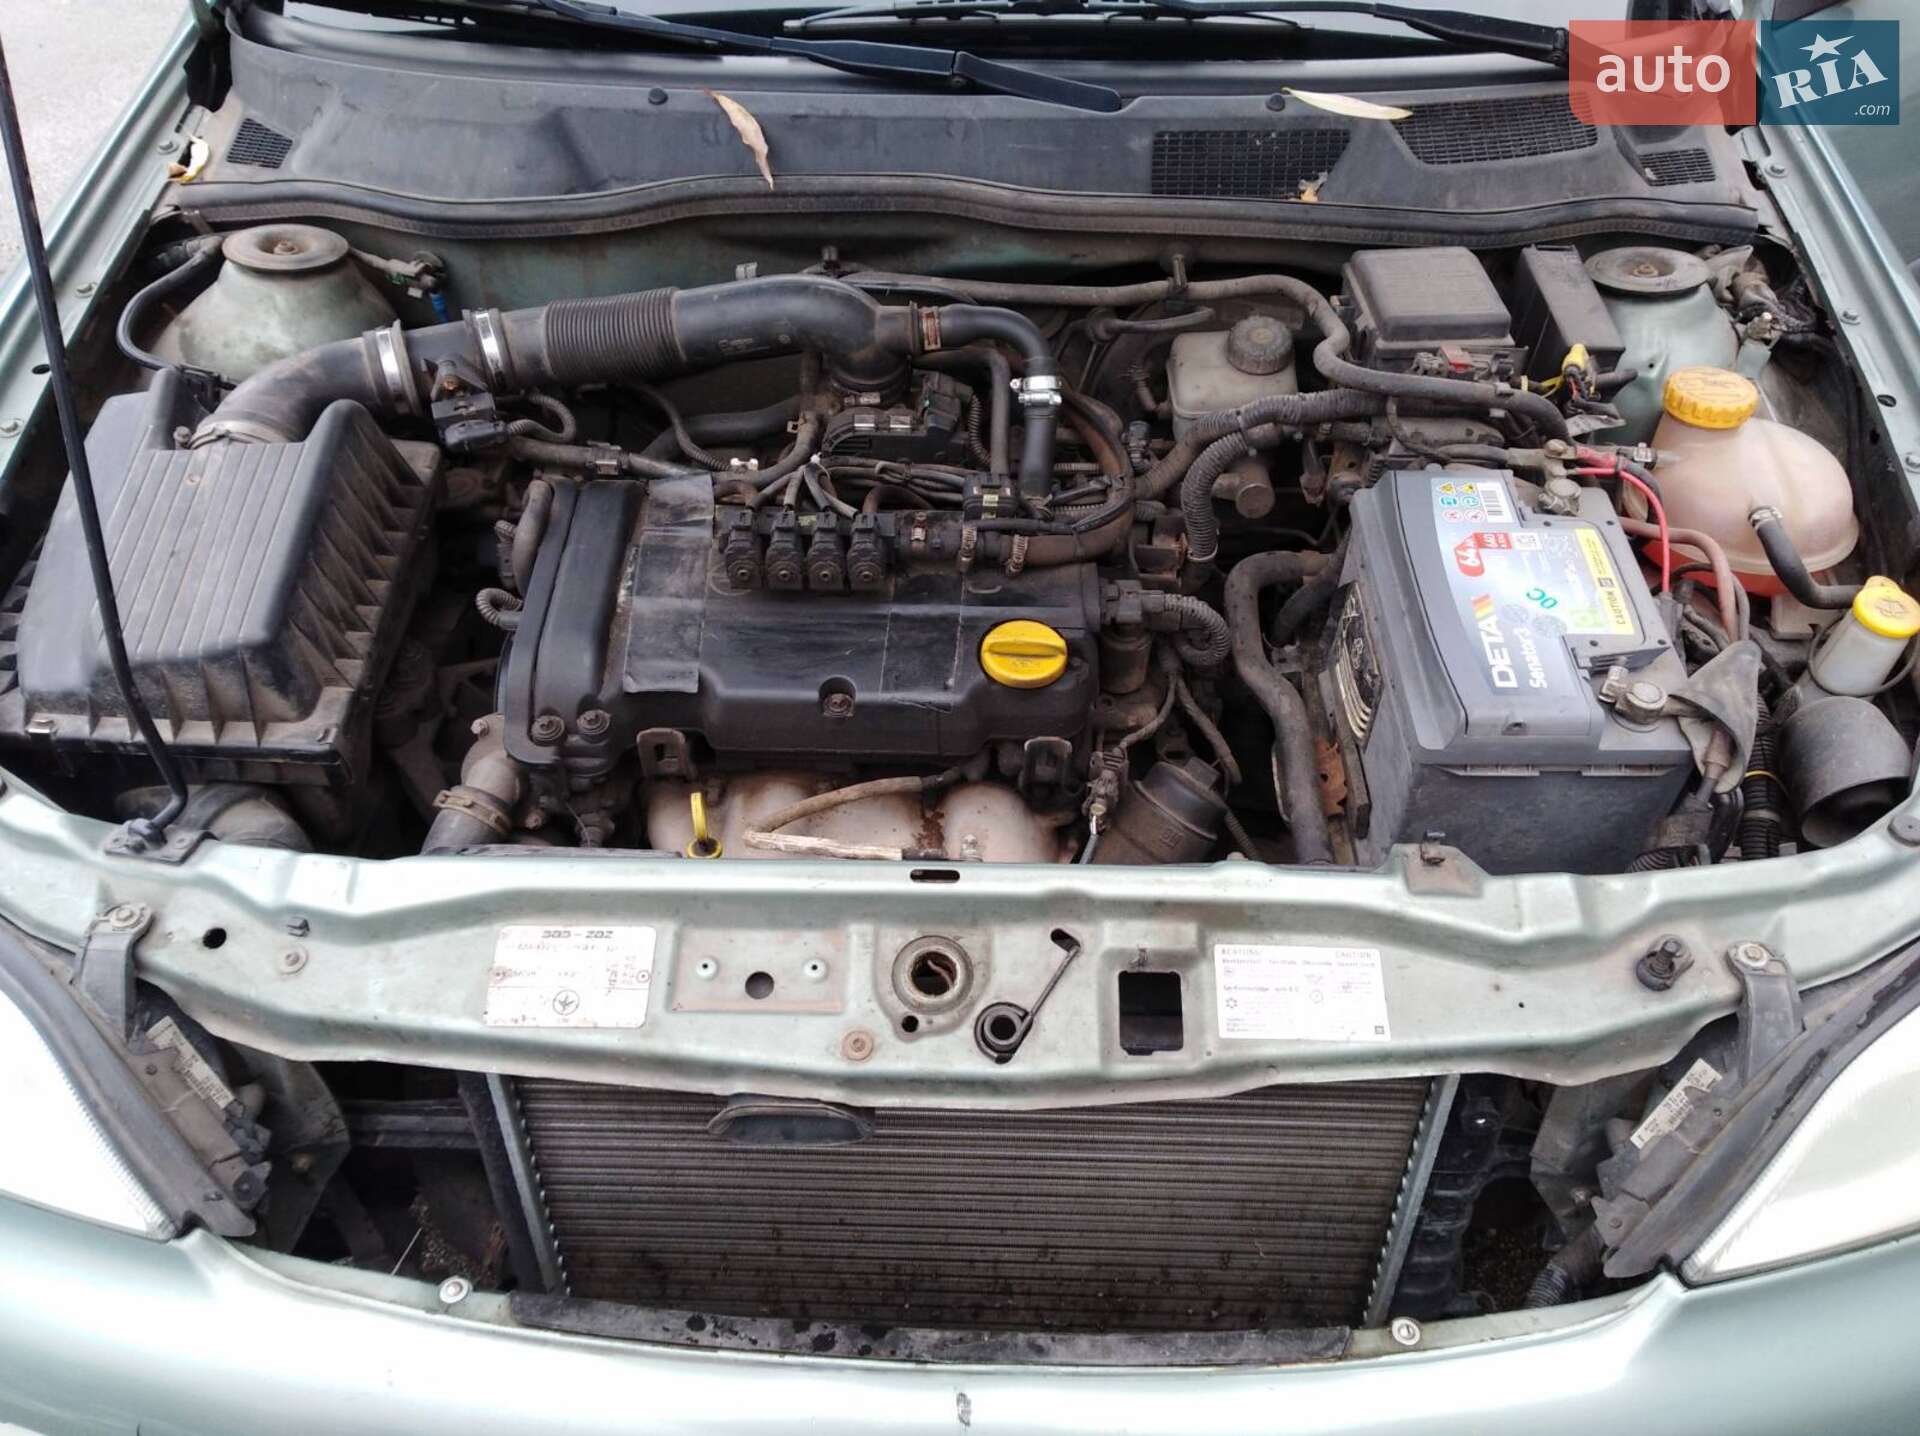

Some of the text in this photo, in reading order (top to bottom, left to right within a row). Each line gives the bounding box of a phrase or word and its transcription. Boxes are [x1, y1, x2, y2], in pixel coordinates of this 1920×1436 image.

[1607, 590, 1627, 626] CAUTION
[1478, 616, 1517, 688] DETA
[1514, 628, 1547, 689] Senator3
